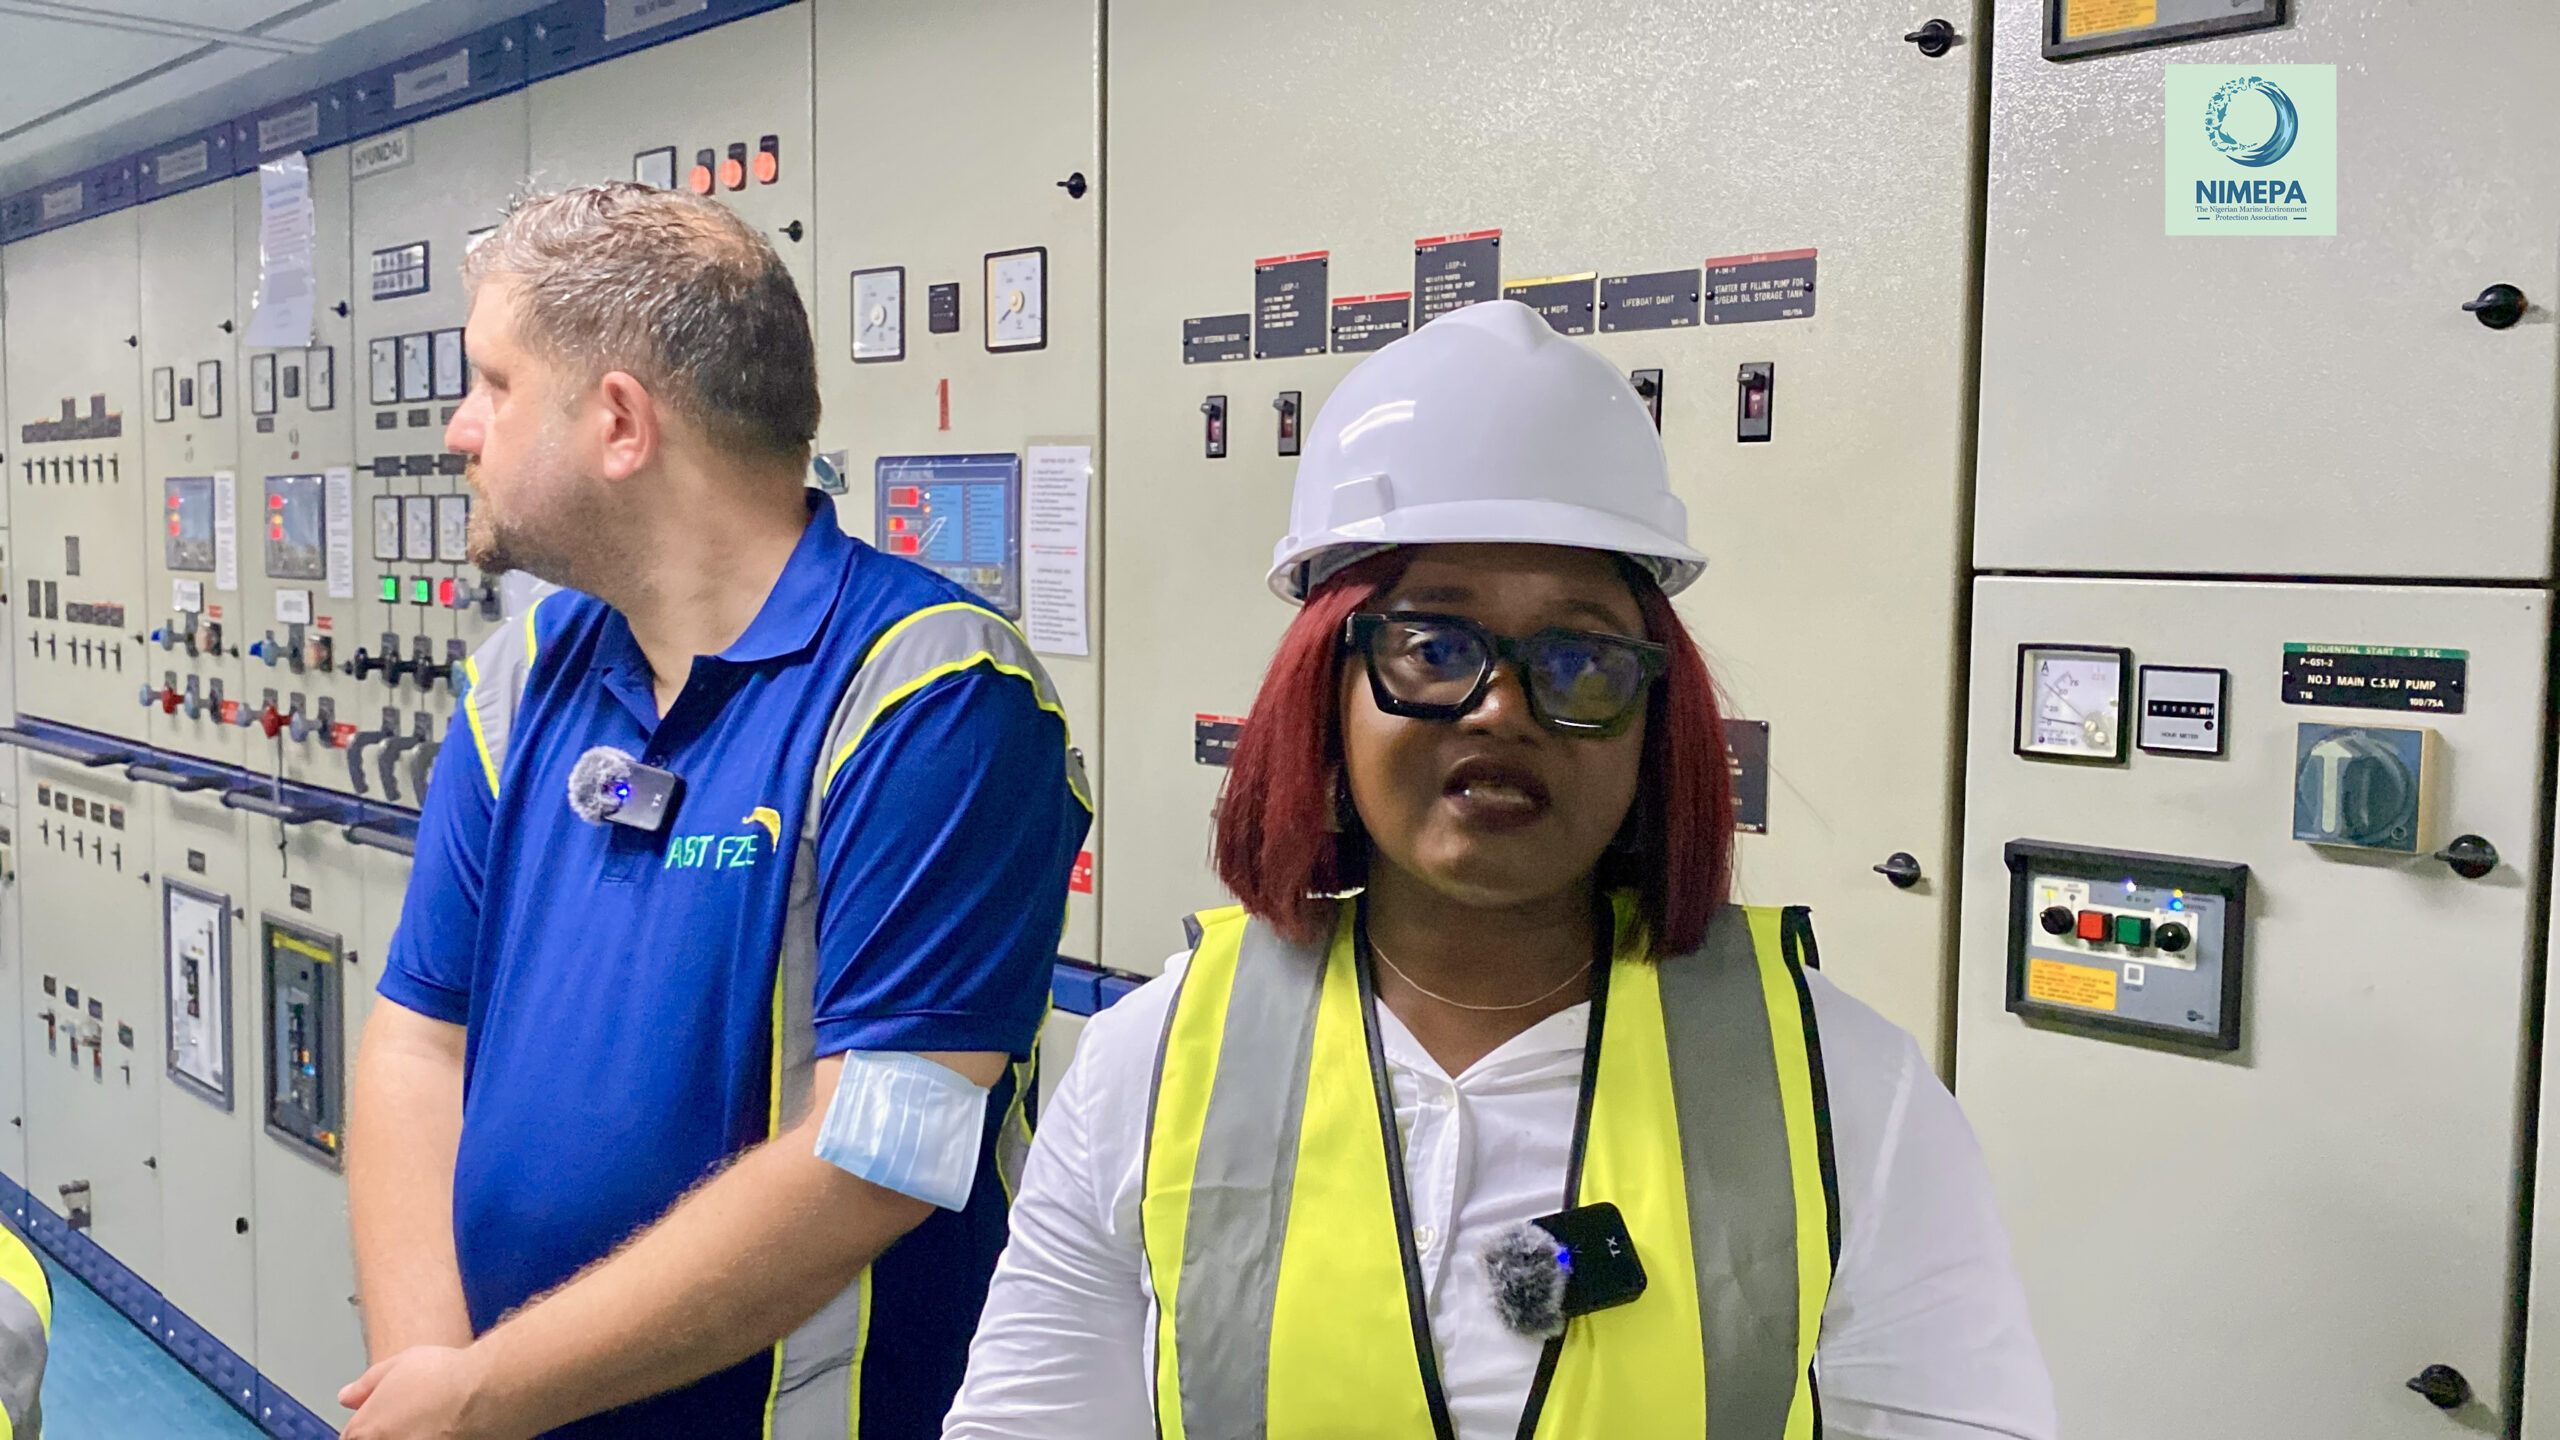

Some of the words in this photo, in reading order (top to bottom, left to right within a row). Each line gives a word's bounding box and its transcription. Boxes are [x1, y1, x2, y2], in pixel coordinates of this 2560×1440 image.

[1715, 283, 1738, 294] STARTER
[1740, 282, 1748, 292] OF
[1774, 279, 1791, 288] PUMP
[1622, 297, 1653, 308] LIFEBOAT
[1754, 291, 1783, 302] STORAGE
[1787, 290, 1804, 298] TANK
[2306, 645, 2360, 655] SEQUENTIAL
[2366, 647, 2394, 656] START
[2424, 650, 2440, 658] SEC
[2041, 661, 2050, 674] A
[2307, 674, 2332, 685] NO.3
[2337, 676, 2364, 687] MAIN
[2370, 678, 2400, 689] C.S.W
[2406, 679, 2437, 691] PUMP
[715, 834, 759, 870] FZE
